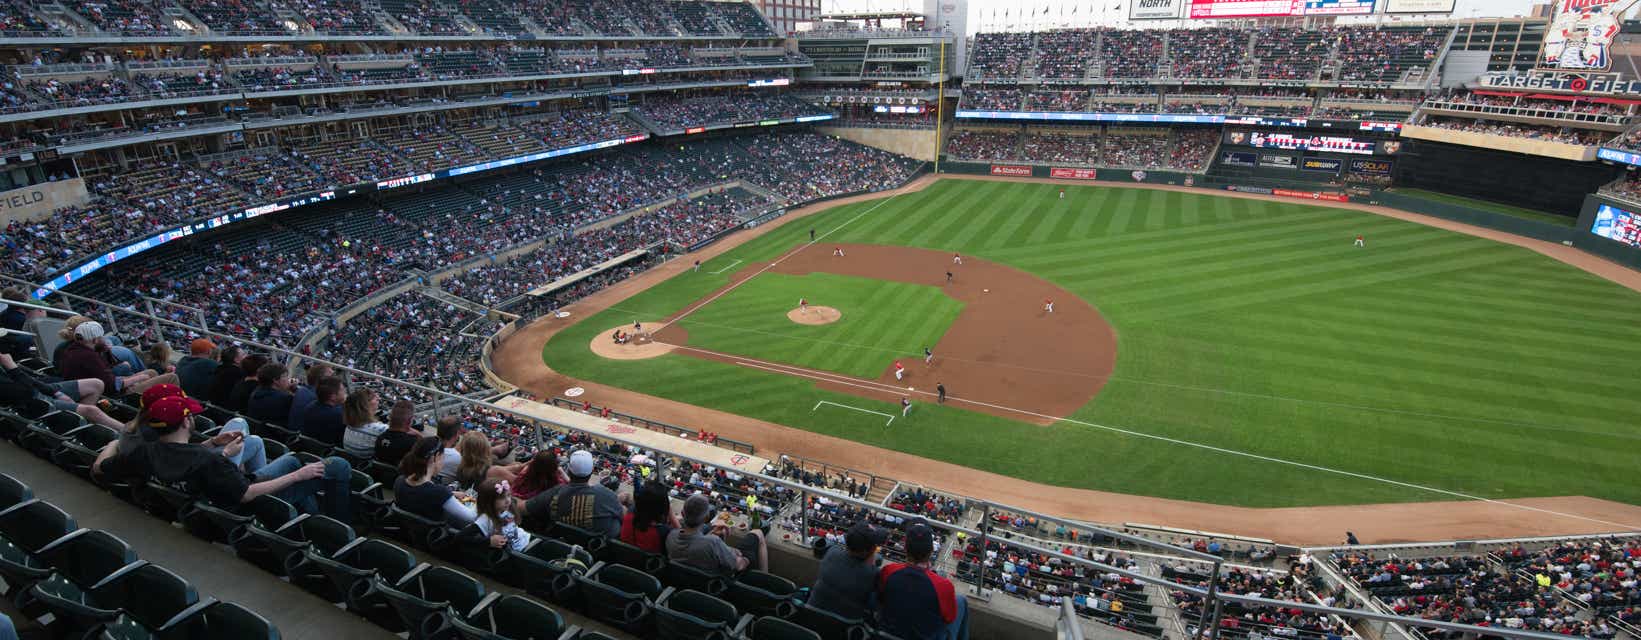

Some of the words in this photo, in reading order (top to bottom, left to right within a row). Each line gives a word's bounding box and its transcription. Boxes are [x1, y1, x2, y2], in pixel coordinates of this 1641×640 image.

[1138, 0, 1171, 8] NORTH
[1489, 75, 1568, 89] TARGET
[1304, 160, 1339, 169] SUBWAY
[0, 191, 44, 208] FIELD
